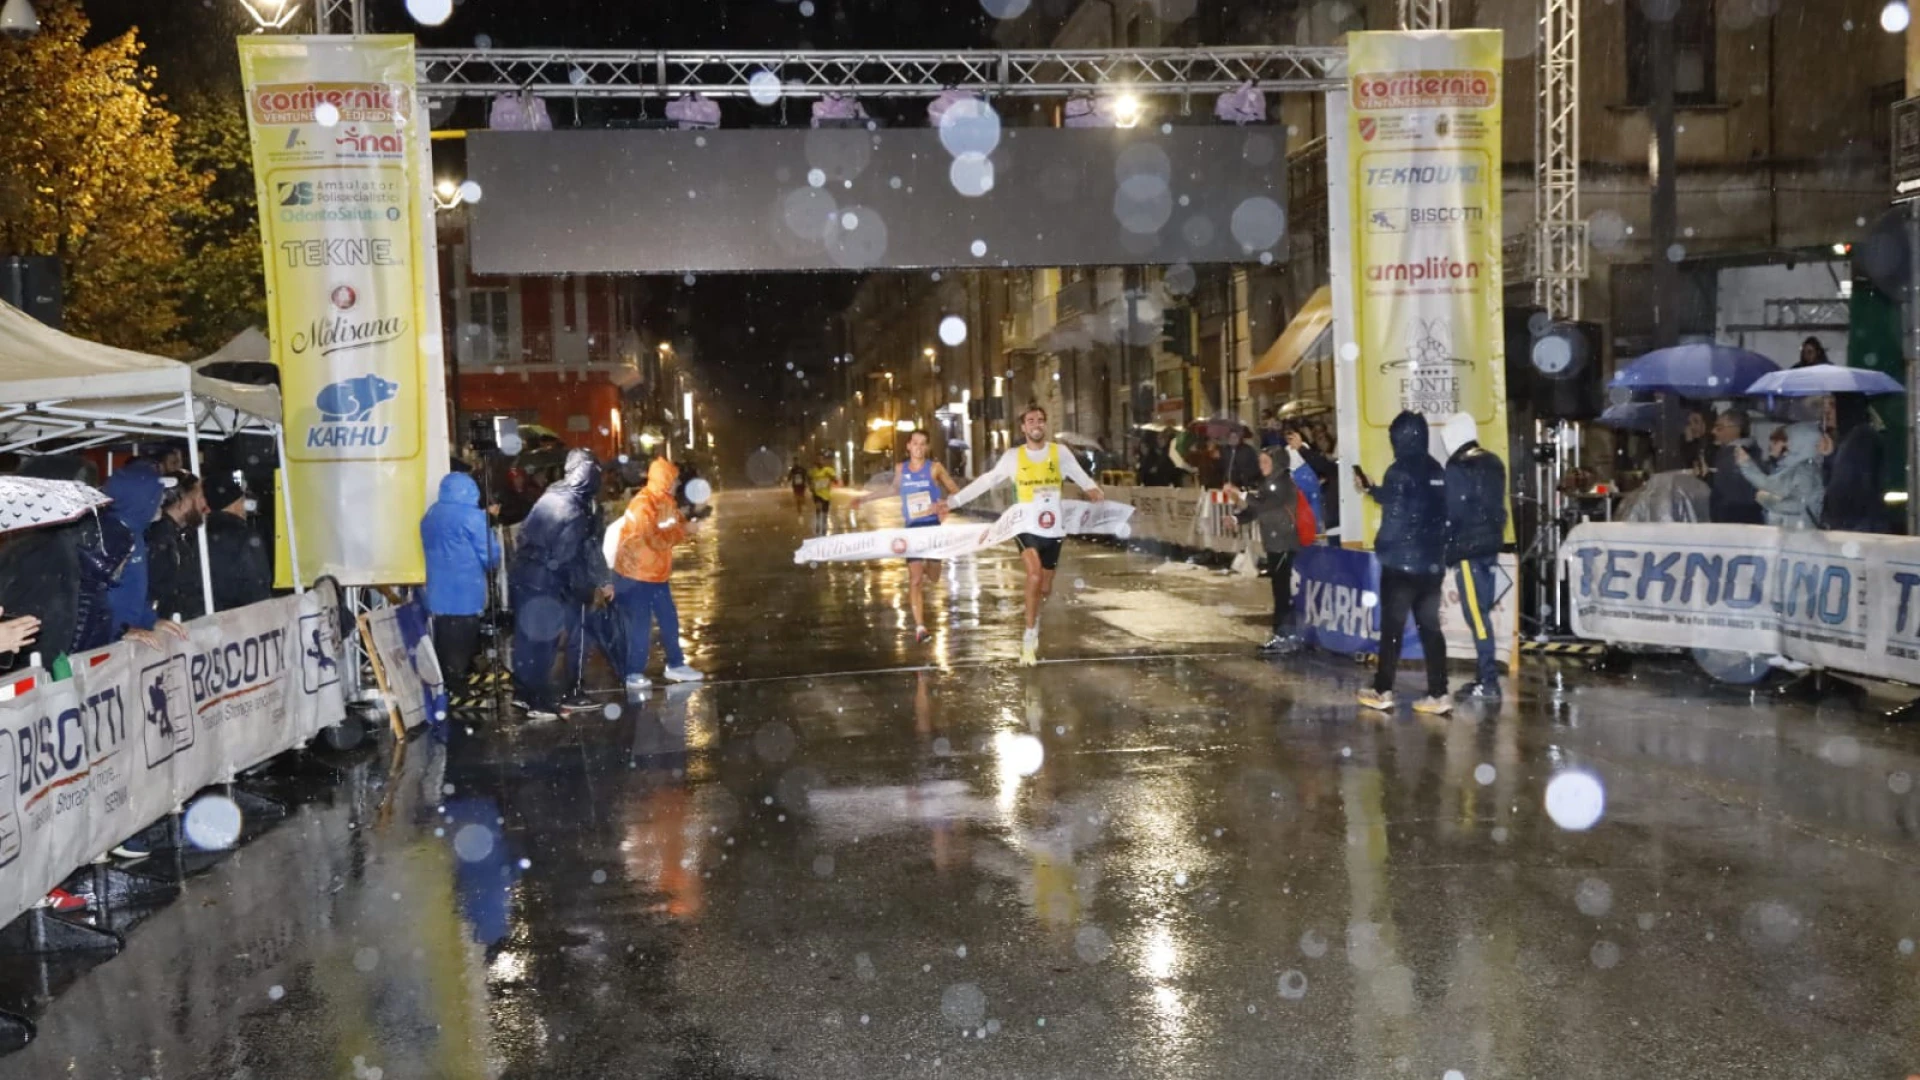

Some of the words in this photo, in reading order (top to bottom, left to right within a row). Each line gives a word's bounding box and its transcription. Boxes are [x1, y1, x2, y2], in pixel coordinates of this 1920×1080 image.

[1361, 74, 1487, 97] corrisernia
[1410, 207, 1482, 222] BISCOTTI
[281, 239, 391, 267] TEKNE
[1366, 256, 1479, 284] amplifon
[1400, 376, 1459, 393] FONTE
[307, 426, 389, 447] KARHU
